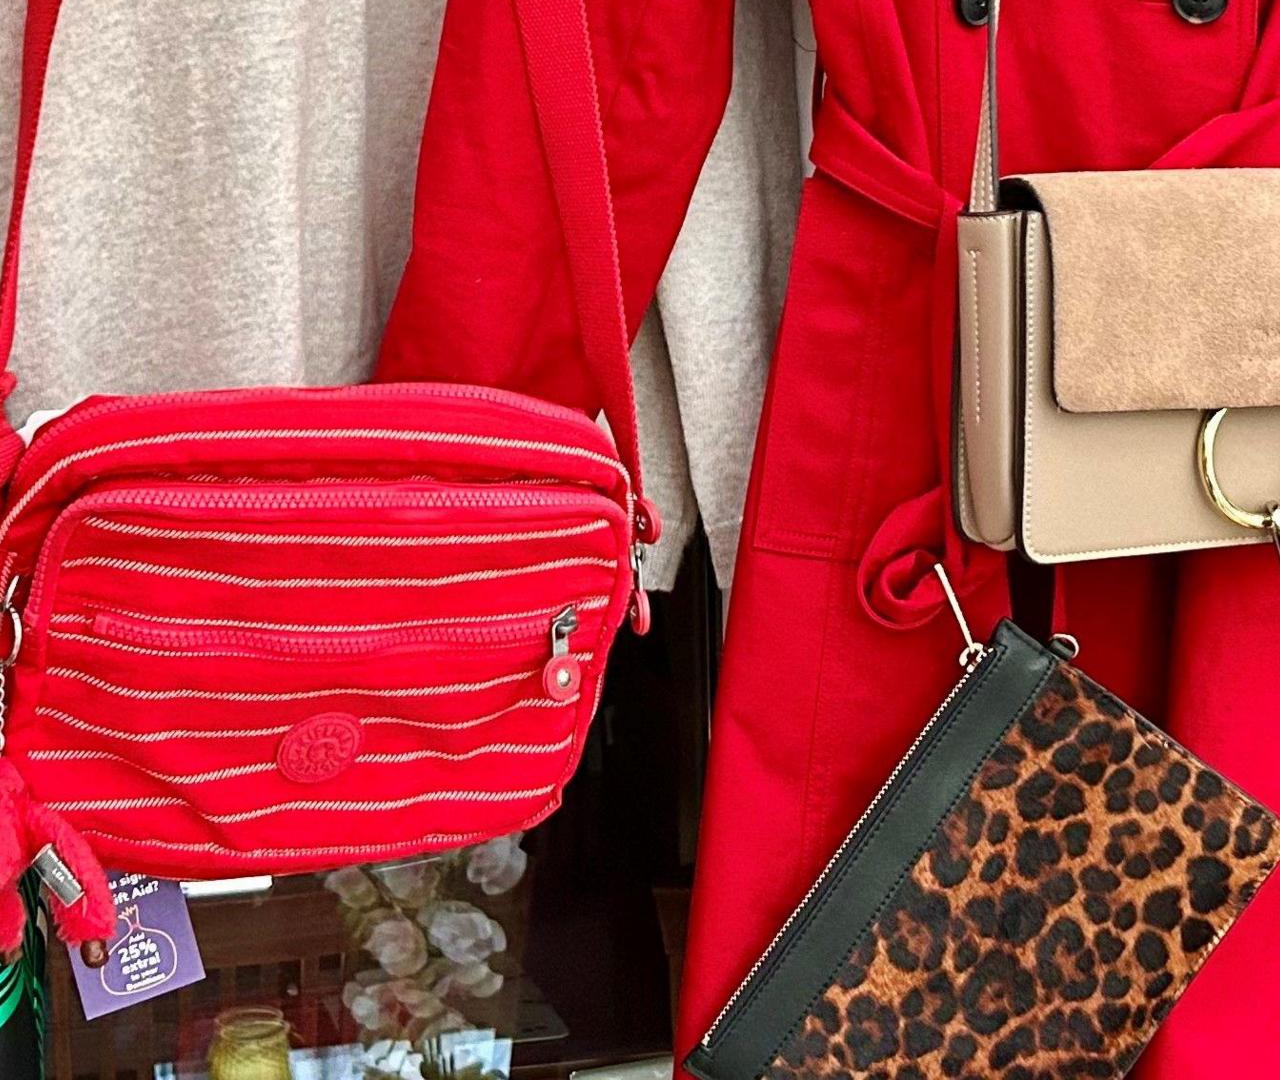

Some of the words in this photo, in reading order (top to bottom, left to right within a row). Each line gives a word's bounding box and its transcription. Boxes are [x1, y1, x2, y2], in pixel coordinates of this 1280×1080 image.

[112, 891, 130, 906] ift
[131, 880, 159, 900] Aid?
[118, 938, 157, 964] 25%
